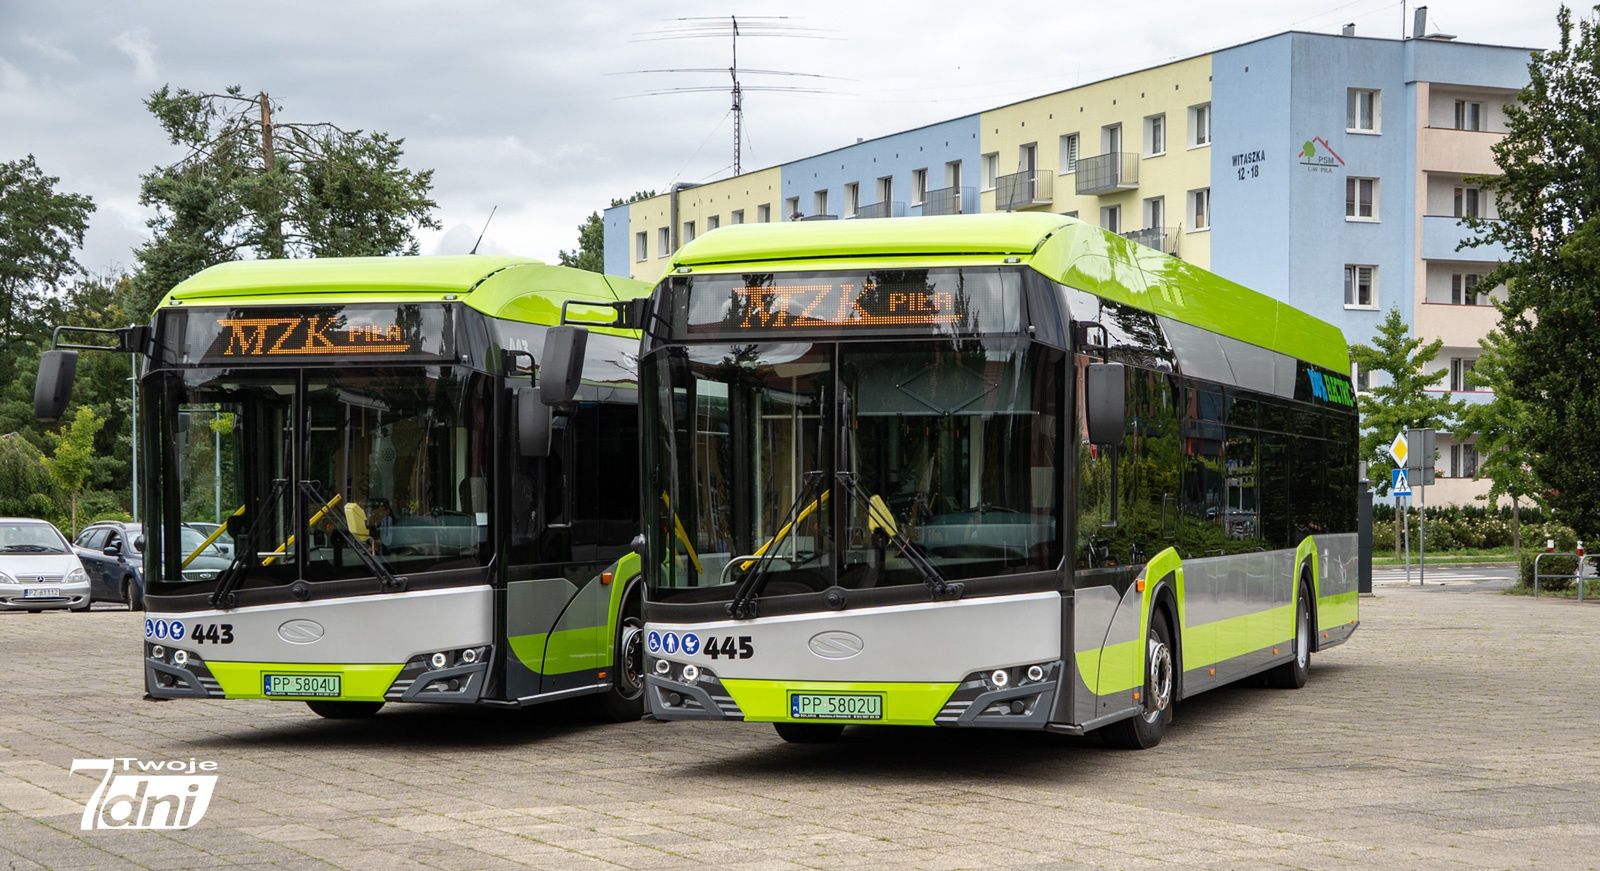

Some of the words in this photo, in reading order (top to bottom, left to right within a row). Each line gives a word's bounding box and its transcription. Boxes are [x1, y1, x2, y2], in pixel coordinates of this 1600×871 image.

[1232, 149, 1265, 167] WITASZKA
[1318, 156, 1335, 164] PSM
[732, 284, 878, 328] MZK
[889, 291, 953, 312] PIŁA
[216, 317, 342, 355] MZK
[348, 324, 401, 342] PIŁA
[191, 623, 234, 644] 443
[703, 636, 754, 660] 445
[273, 677, 290, 691] PP
[295, 677, 336, 692] 5804U
[802, 697, 822, 712] PP
[828, 697, 876, 713] 5802U
